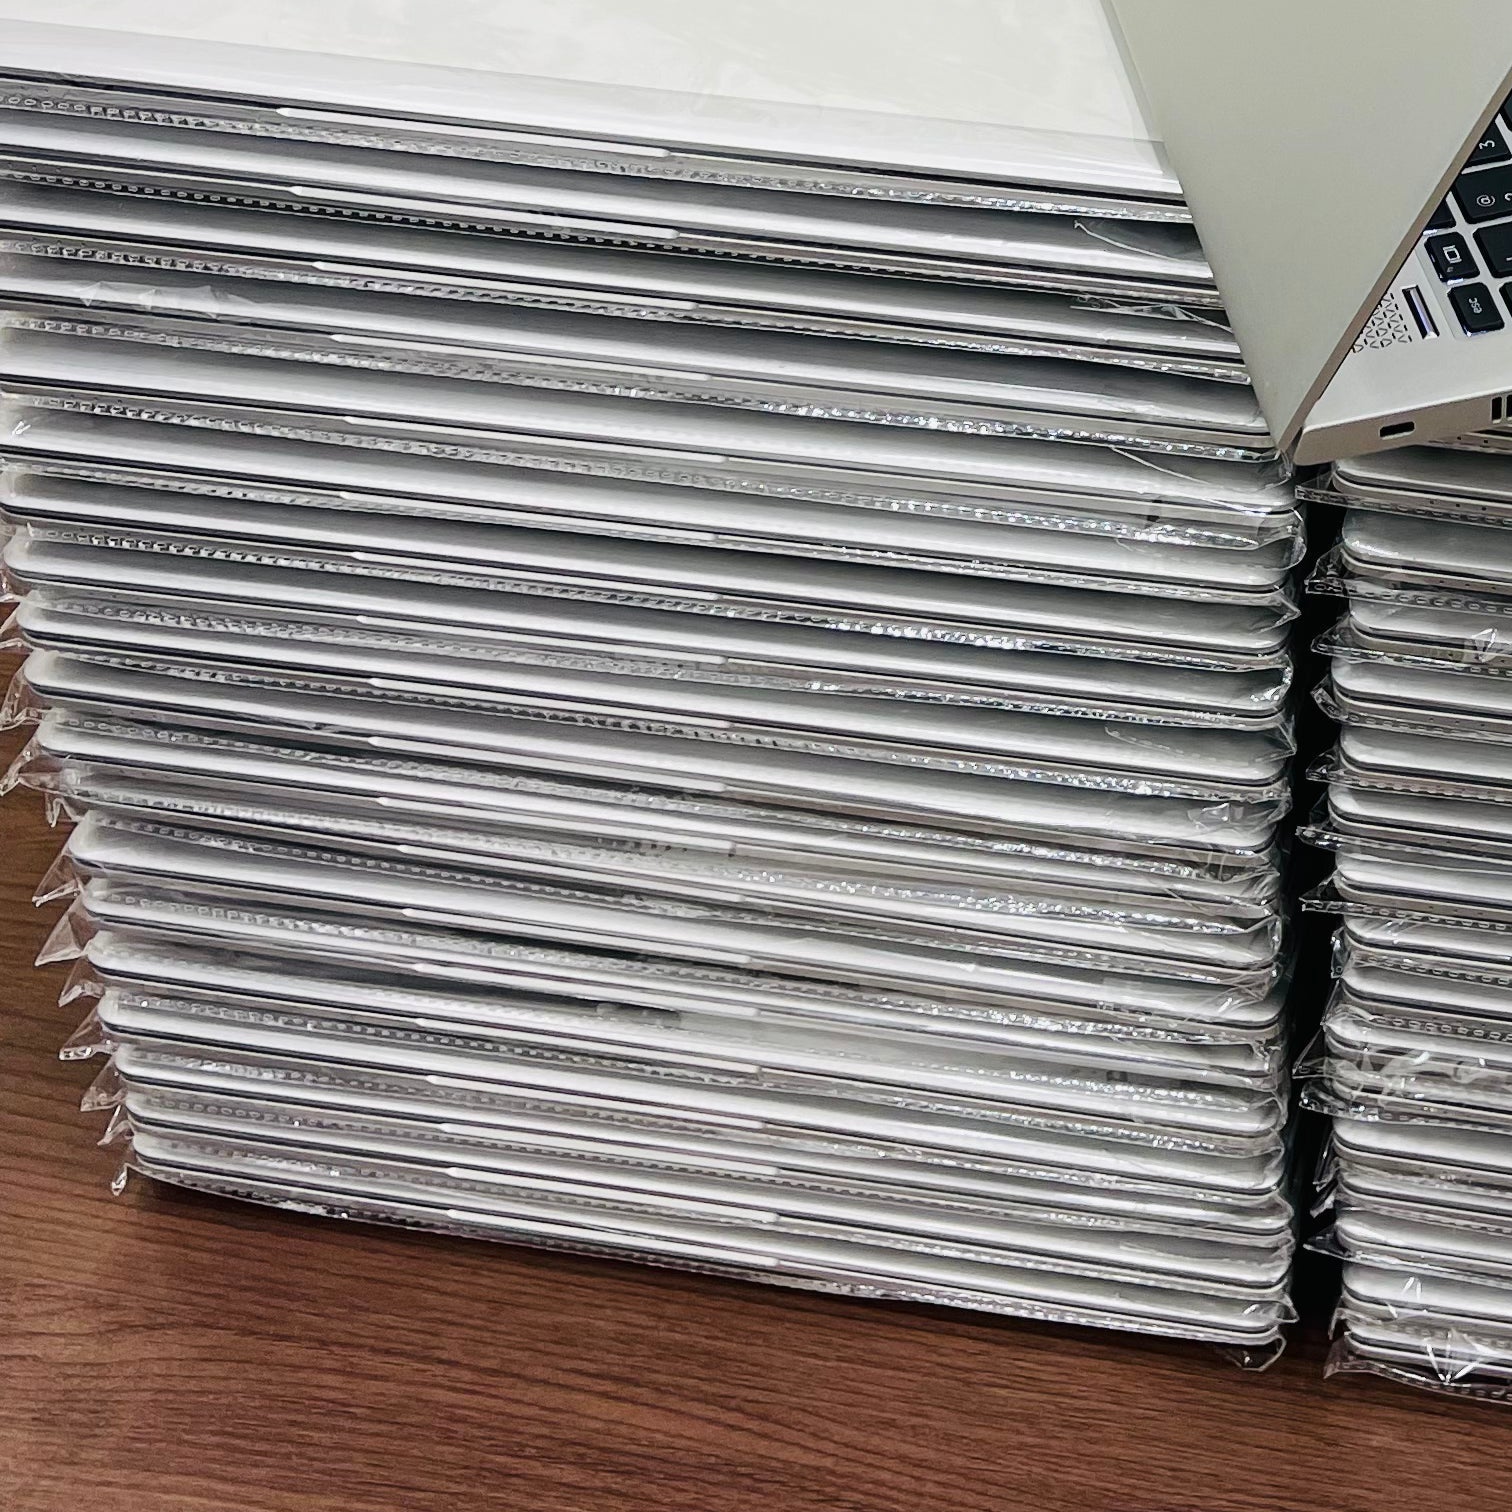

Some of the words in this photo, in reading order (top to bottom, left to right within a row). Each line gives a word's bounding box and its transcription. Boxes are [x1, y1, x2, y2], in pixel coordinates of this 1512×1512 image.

[1478, 140, 1496, 150] 3
[1476, 194, 1496, 207] @
[1468, 297, 1483, 314] esc
